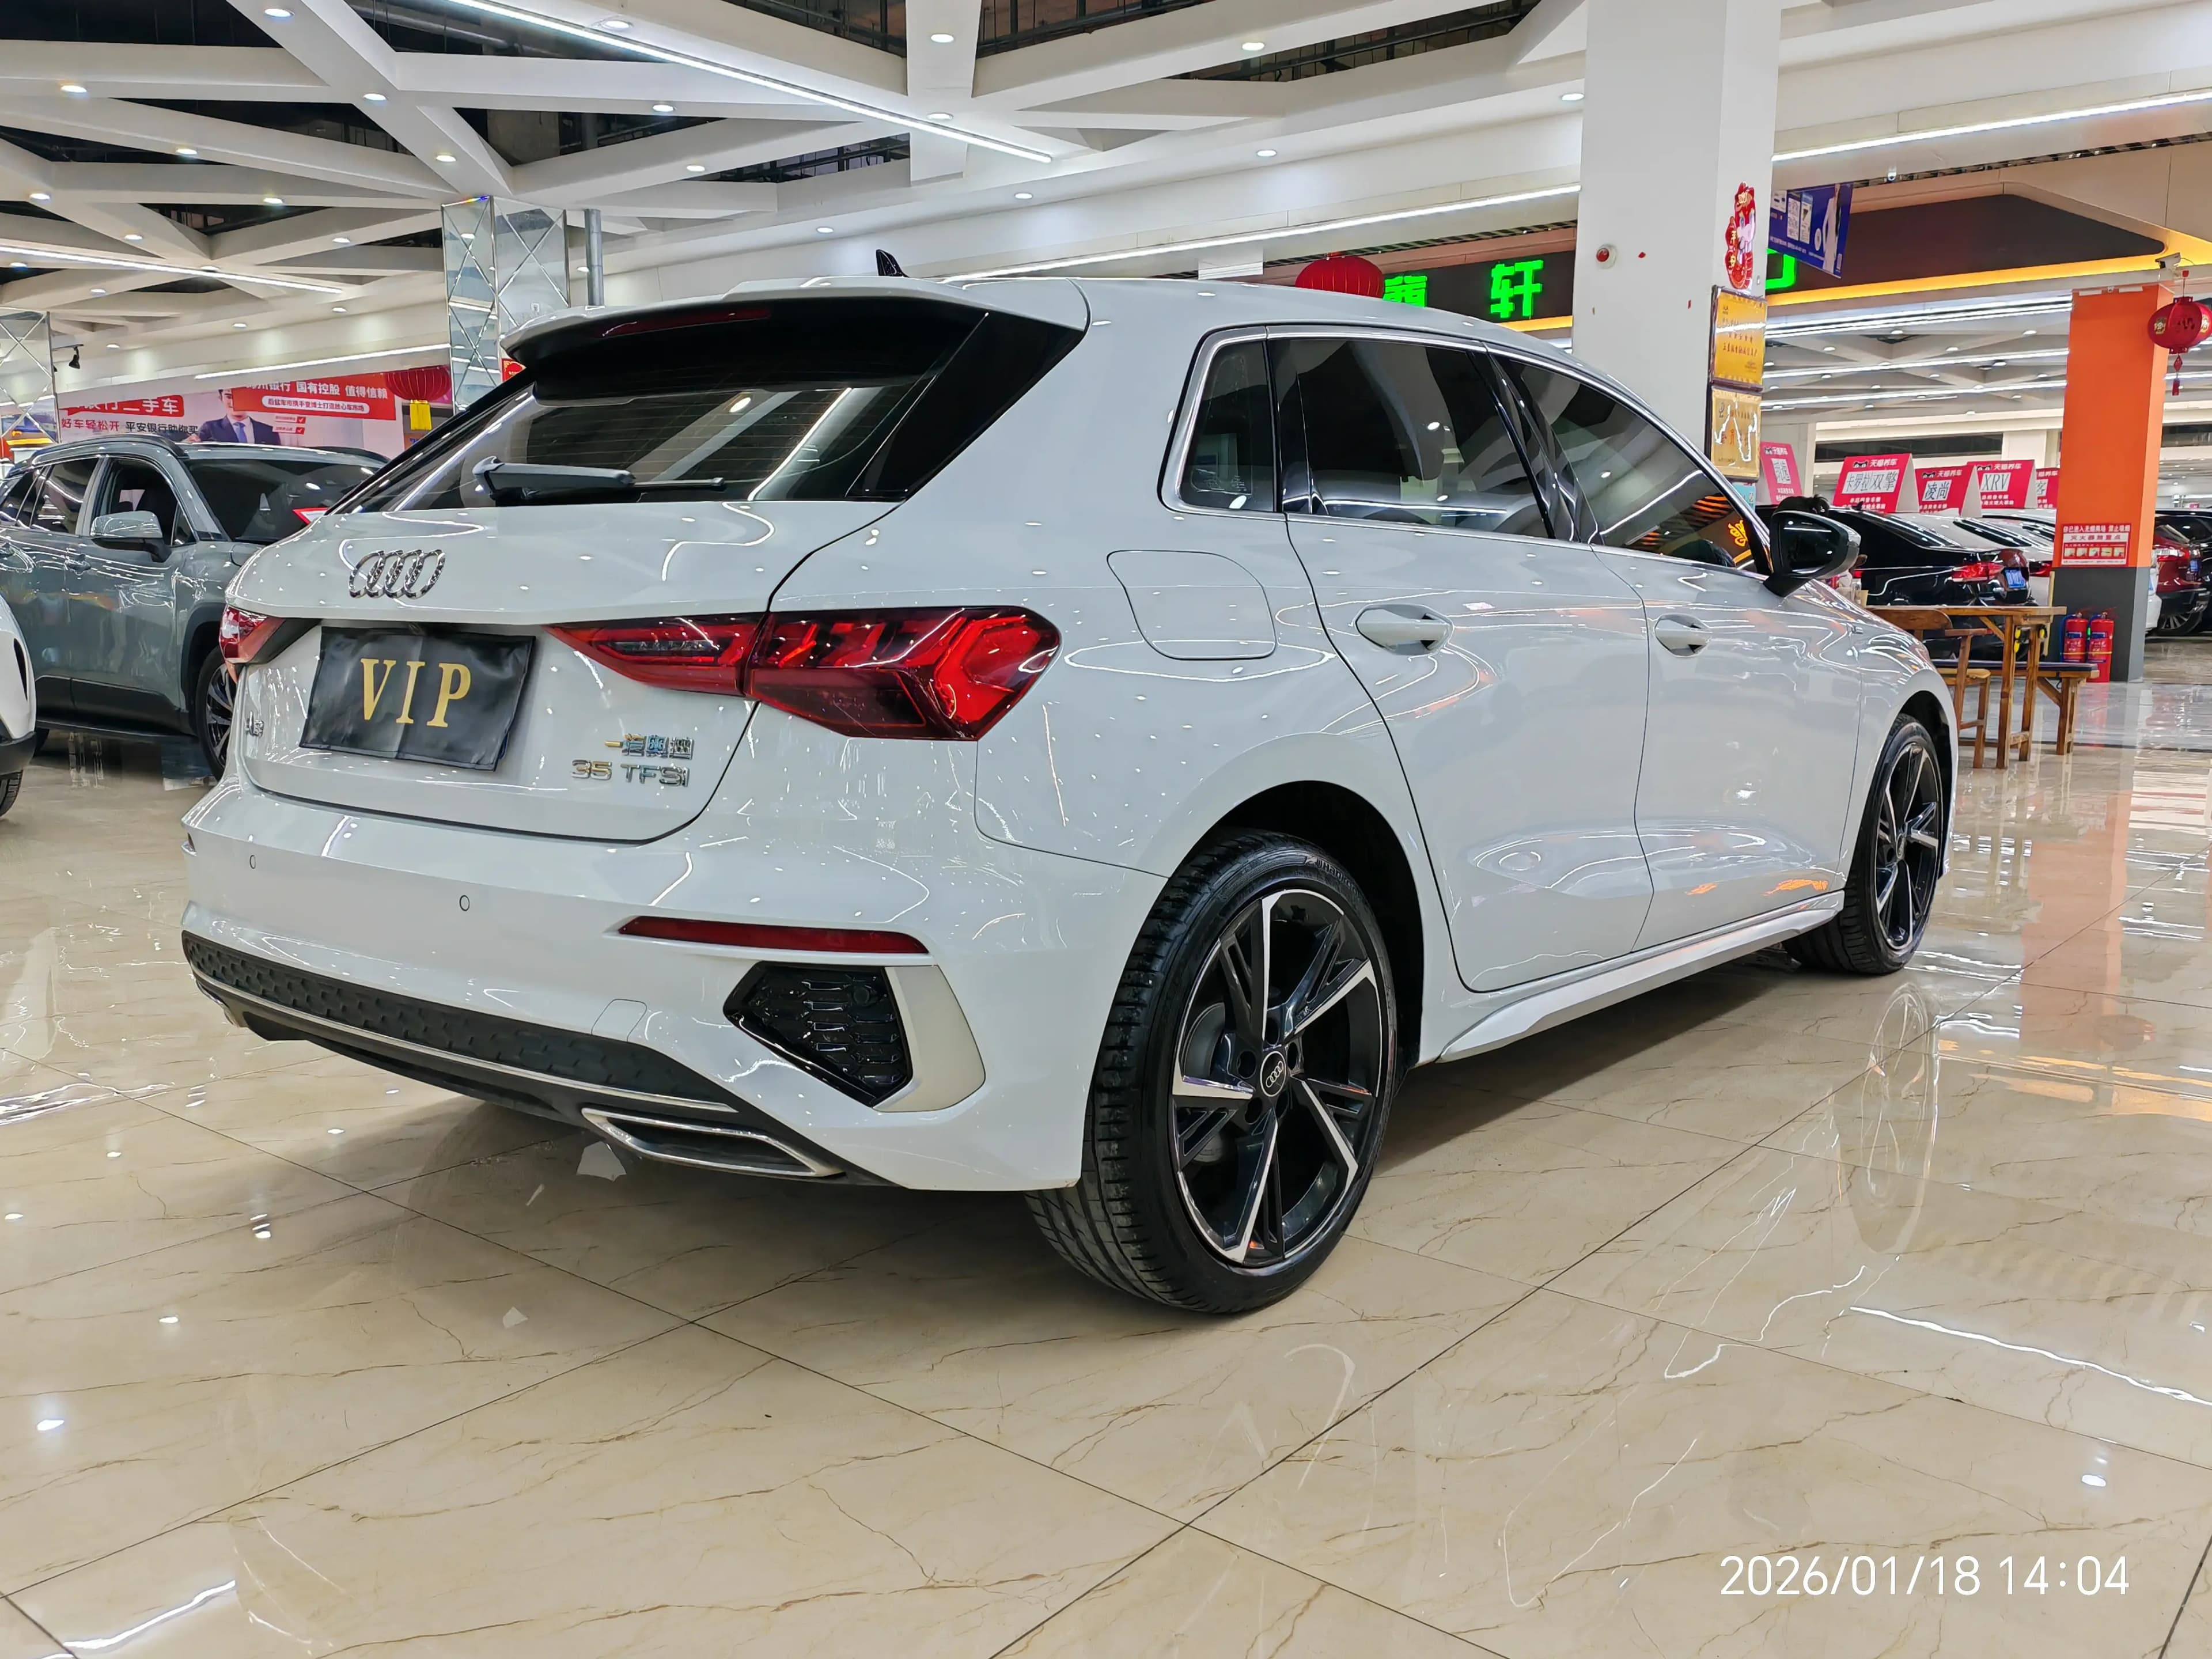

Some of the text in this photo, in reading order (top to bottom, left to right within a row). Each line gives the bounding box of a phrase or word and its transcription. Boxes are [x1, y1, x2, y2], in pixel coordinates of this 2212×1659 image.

[296, 381, 340, 396] 国有控股
[62, 418, 198, 434] 好车轻松开 平安银行助你买
[1869, 459, 1898, 467] 天猫养车
[1847, 472, 1897, 492] 卡罗拉双擎
[1937, 469, 1963, 478] 天猫养车
[1981, 474, 2009, 491] XRV
[1925, 481, 1949, 500] 凌尚
[360, 658, 471, 728] VIP
[604, 733, 695, 760] 一汽奥迪
[571, 759, 690, 787] 35 TFSI
